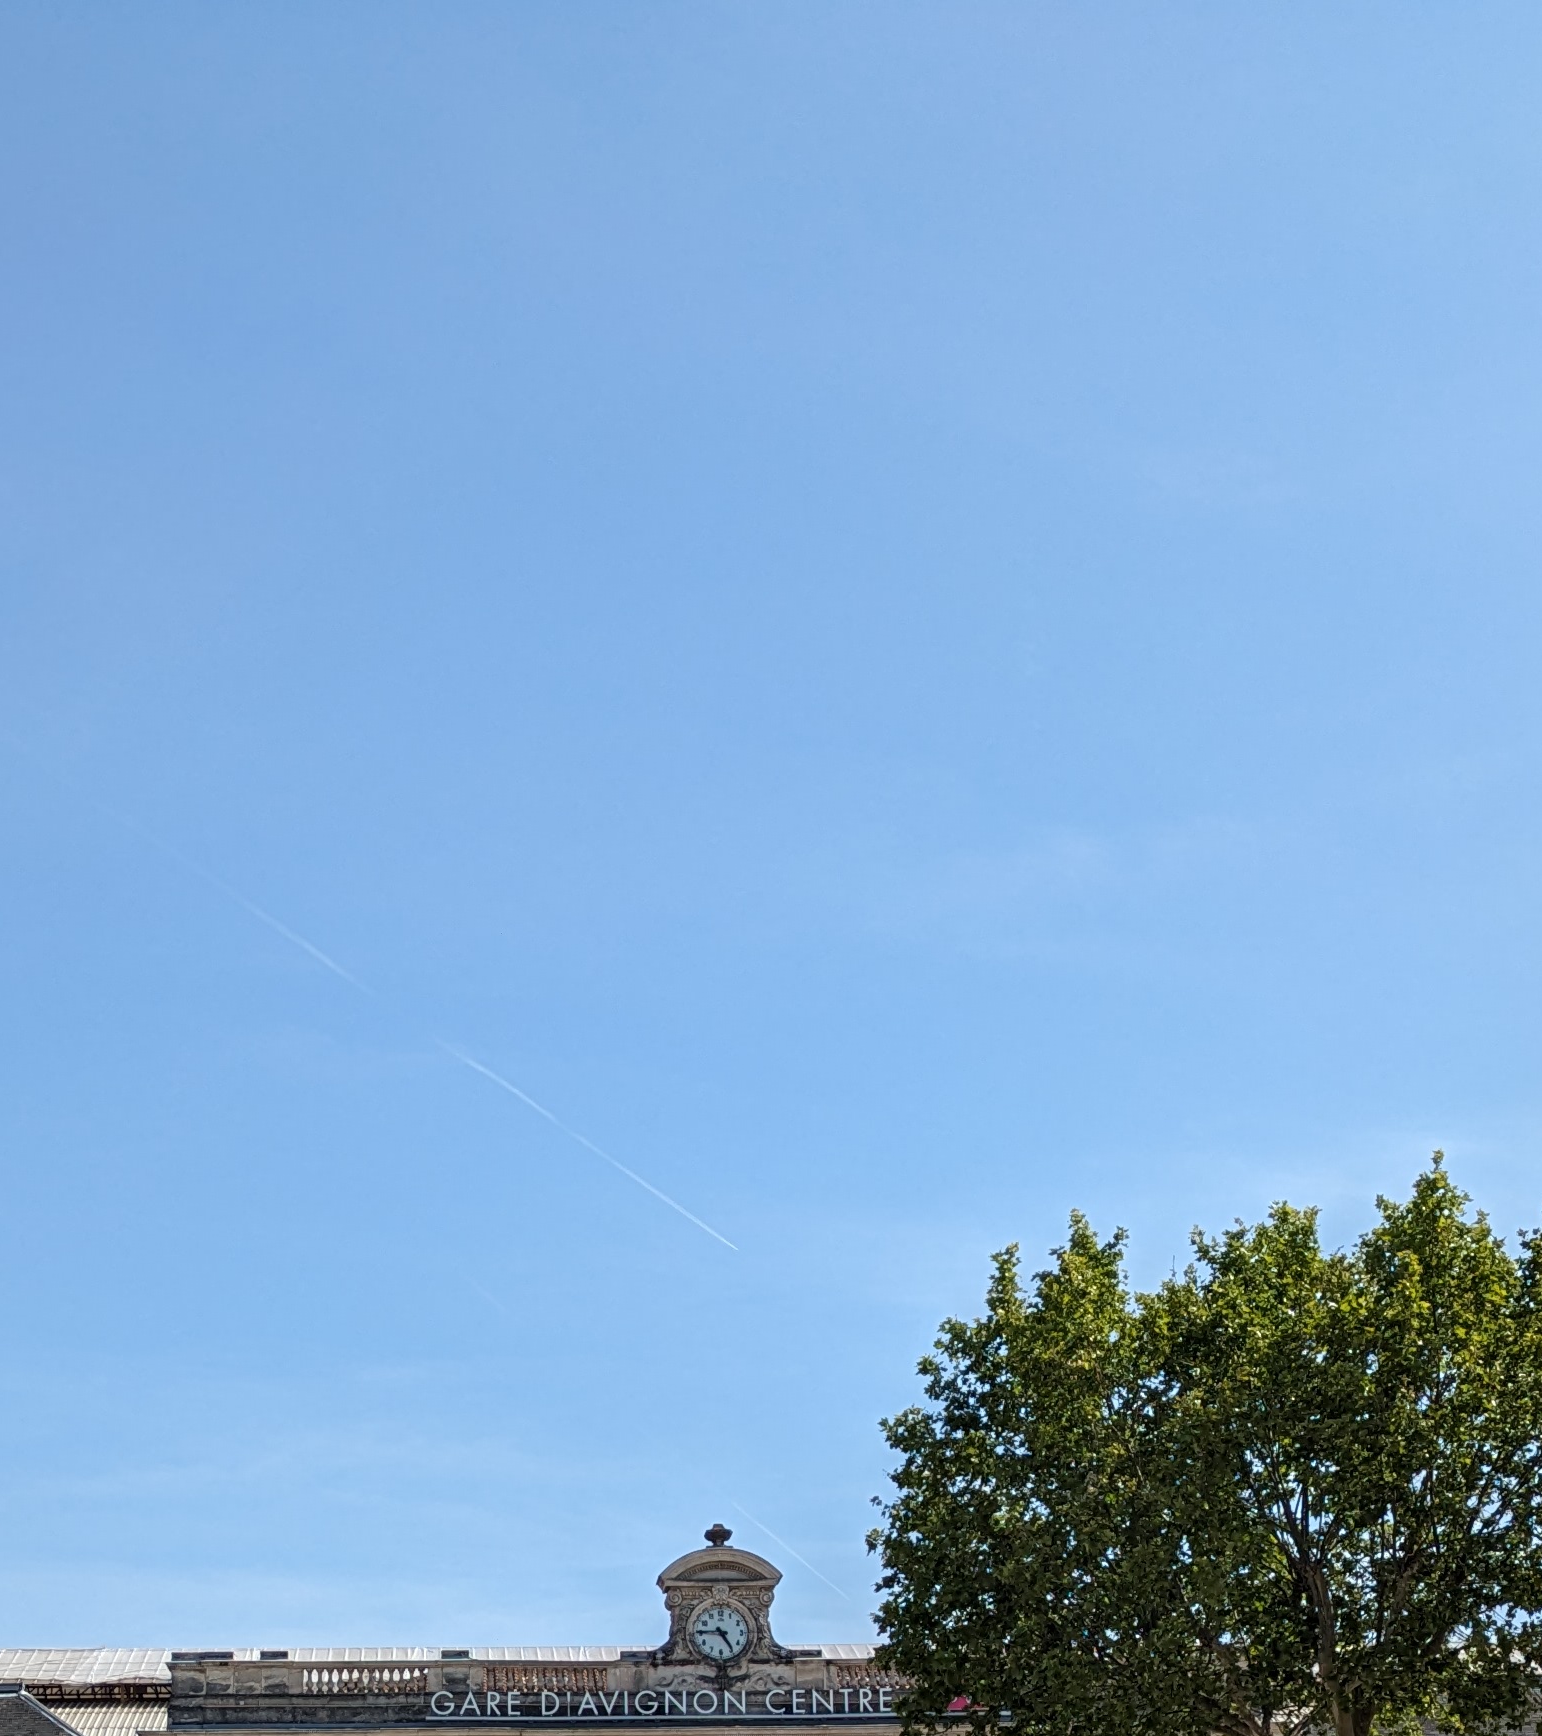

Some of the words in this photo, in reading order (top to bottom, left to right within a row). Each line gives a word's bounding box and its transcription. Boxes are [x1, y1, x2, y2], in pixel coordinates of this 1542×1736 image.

[430, 1690, 521, 1716] GARE
[541, 1689, 746, 1716] D'AVIGNON
[765, 1688, 893, 1714] CENTRE
